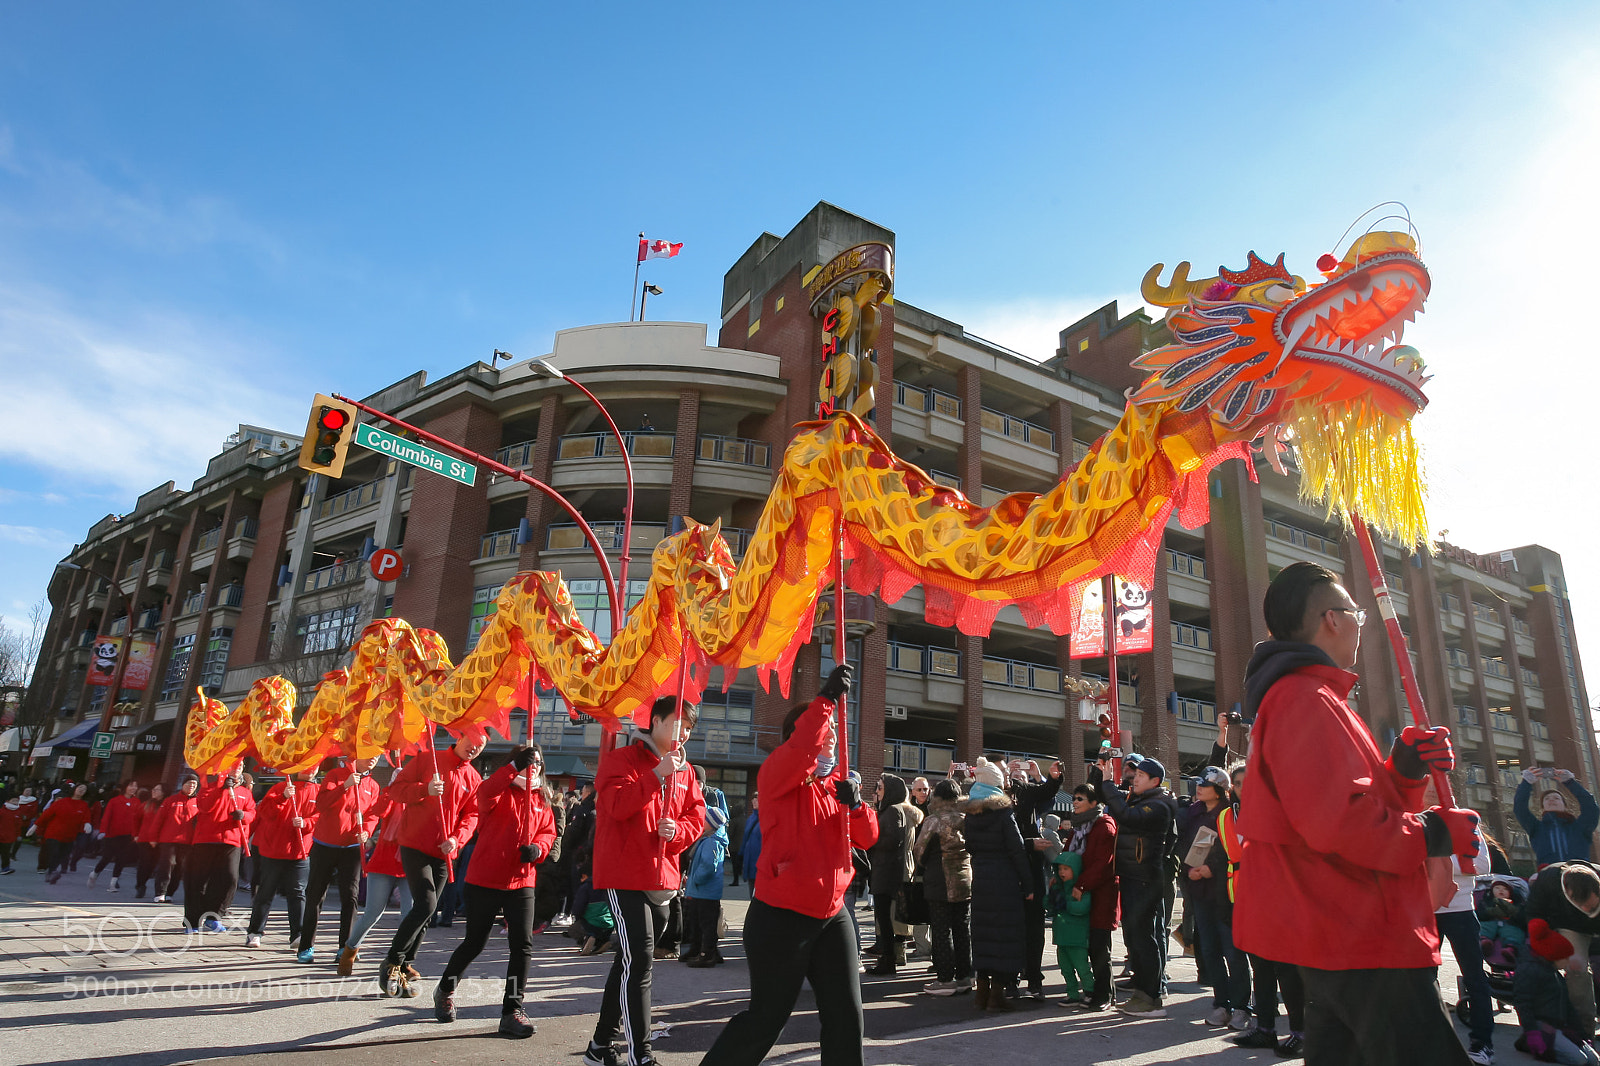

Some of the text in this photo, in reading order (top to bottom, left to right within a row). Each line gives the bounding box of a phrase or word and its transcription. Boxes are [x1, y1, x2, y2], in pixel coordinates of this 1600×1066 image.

[367, 431, 467, 480] Columbia St
[377, 553, 397, 575] P
[96, 735, 111, 748] P
